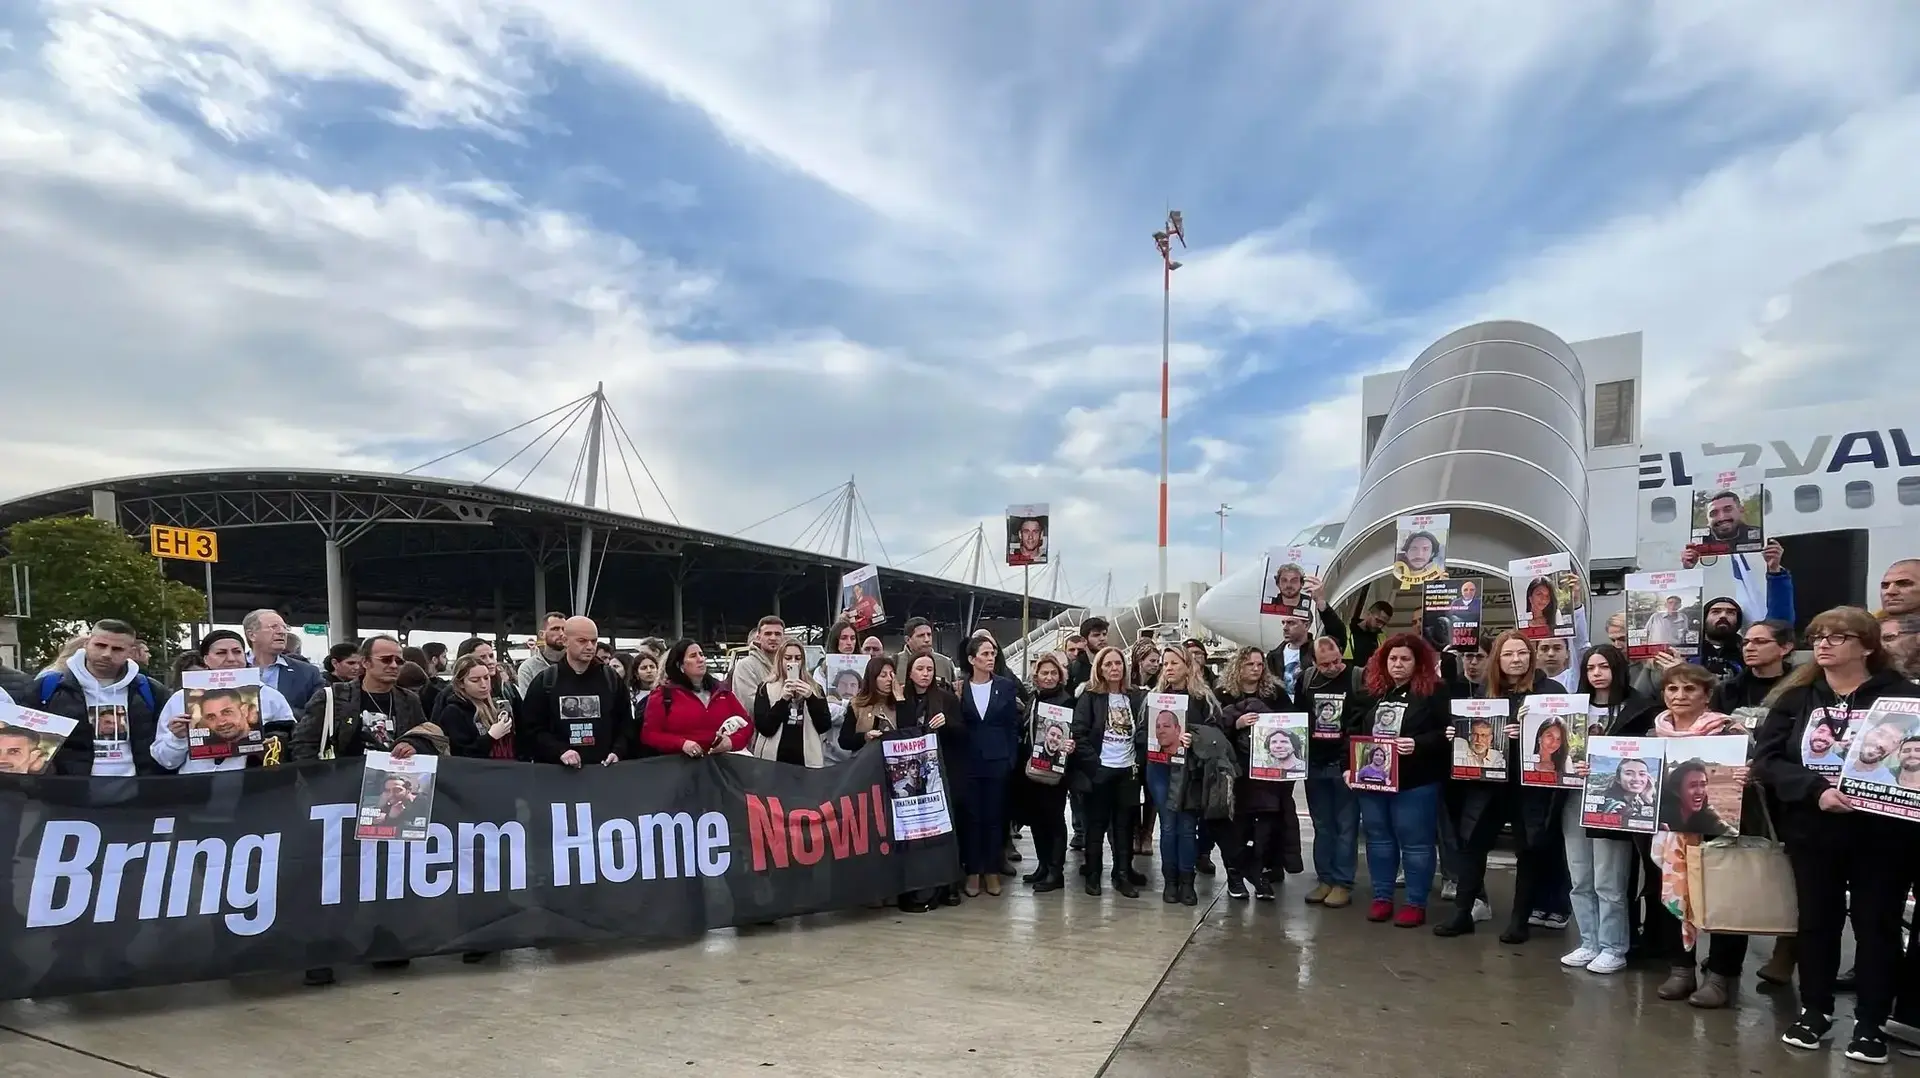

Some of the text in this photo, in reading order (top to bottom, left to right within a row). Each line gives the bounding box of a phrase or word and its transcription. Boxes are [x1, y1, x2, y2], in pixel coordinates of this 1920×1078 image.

[1639, 452, 1692, 489] EL
[1826, 429, 1920, 472] AL
[156, 529, 213, 558] EH 3
[189, 728, 211, 737] BRING
[1844, 779, 1887, 793] Ziv&Gali
[1857, 791, 1878, 799] years
[1584, 804, 1598, 812] HER
[26, 817, 281, 937] Bring
[309, 802, 527, 905] Them
[551, 802, 731, 887] Home
